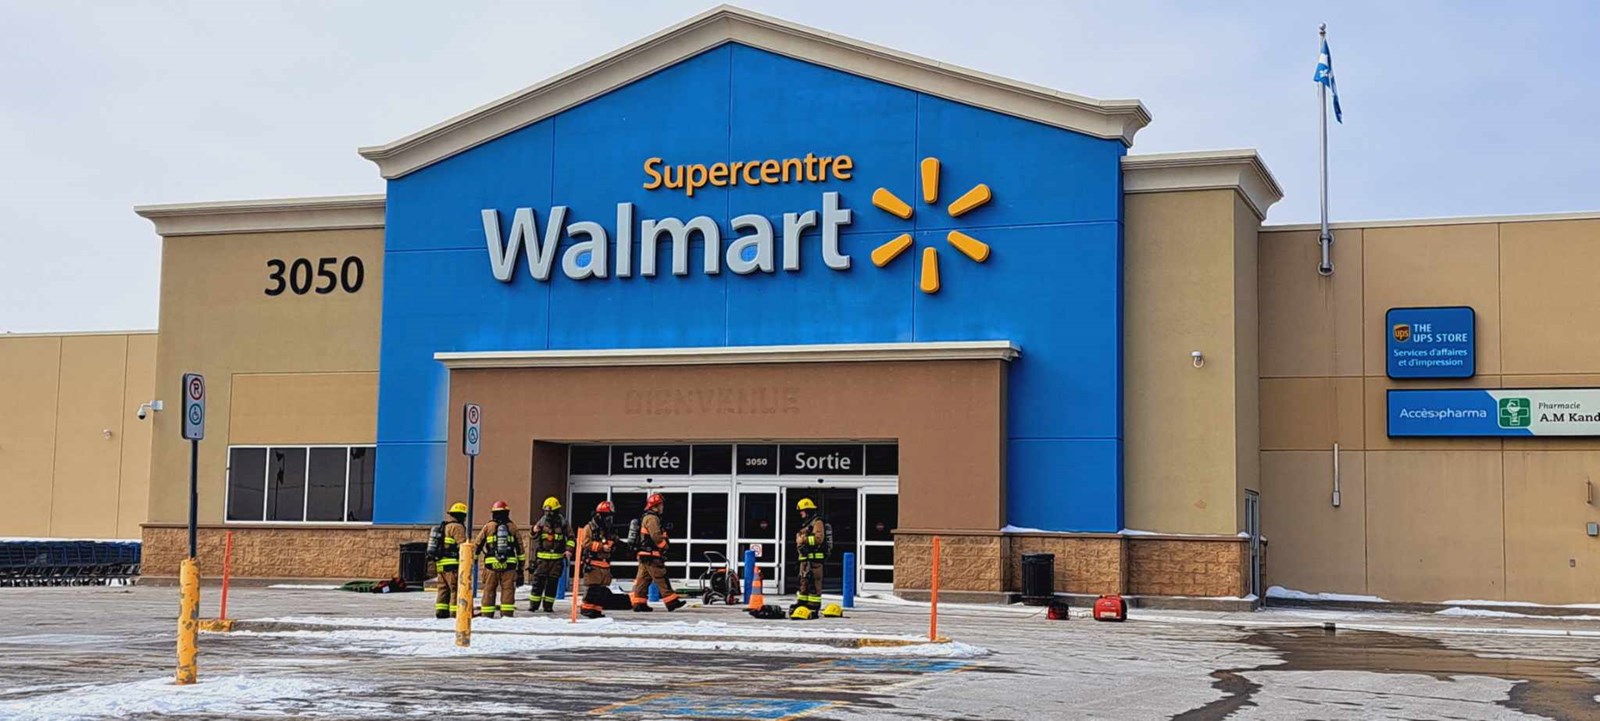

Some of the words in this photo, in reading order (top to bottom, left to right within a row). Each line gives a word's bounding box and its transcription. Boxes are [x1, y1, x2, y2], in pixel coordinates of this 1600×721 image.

[642, 152, 853, 196] Supercentre
[481, 191, 852, 283] Walmart
[264, 255, 365, 297] 3050
[1413, 323, 1432, 333] THE
[1413, 333, 1433, 343] UPS
[1436, 333, 1468, 342] STORE
[1393, 349, 1428, 357] Services
[1429, 348, 1468, 356] d'affaires
[1408, 359, 1464, 368] d'impression
[1540, 413, 1565, 422] A.M
[623, 452, 680, 469] Entrée
[745, 458, 768, 466] 3050
[795, 452, 851, 470] Sortie
